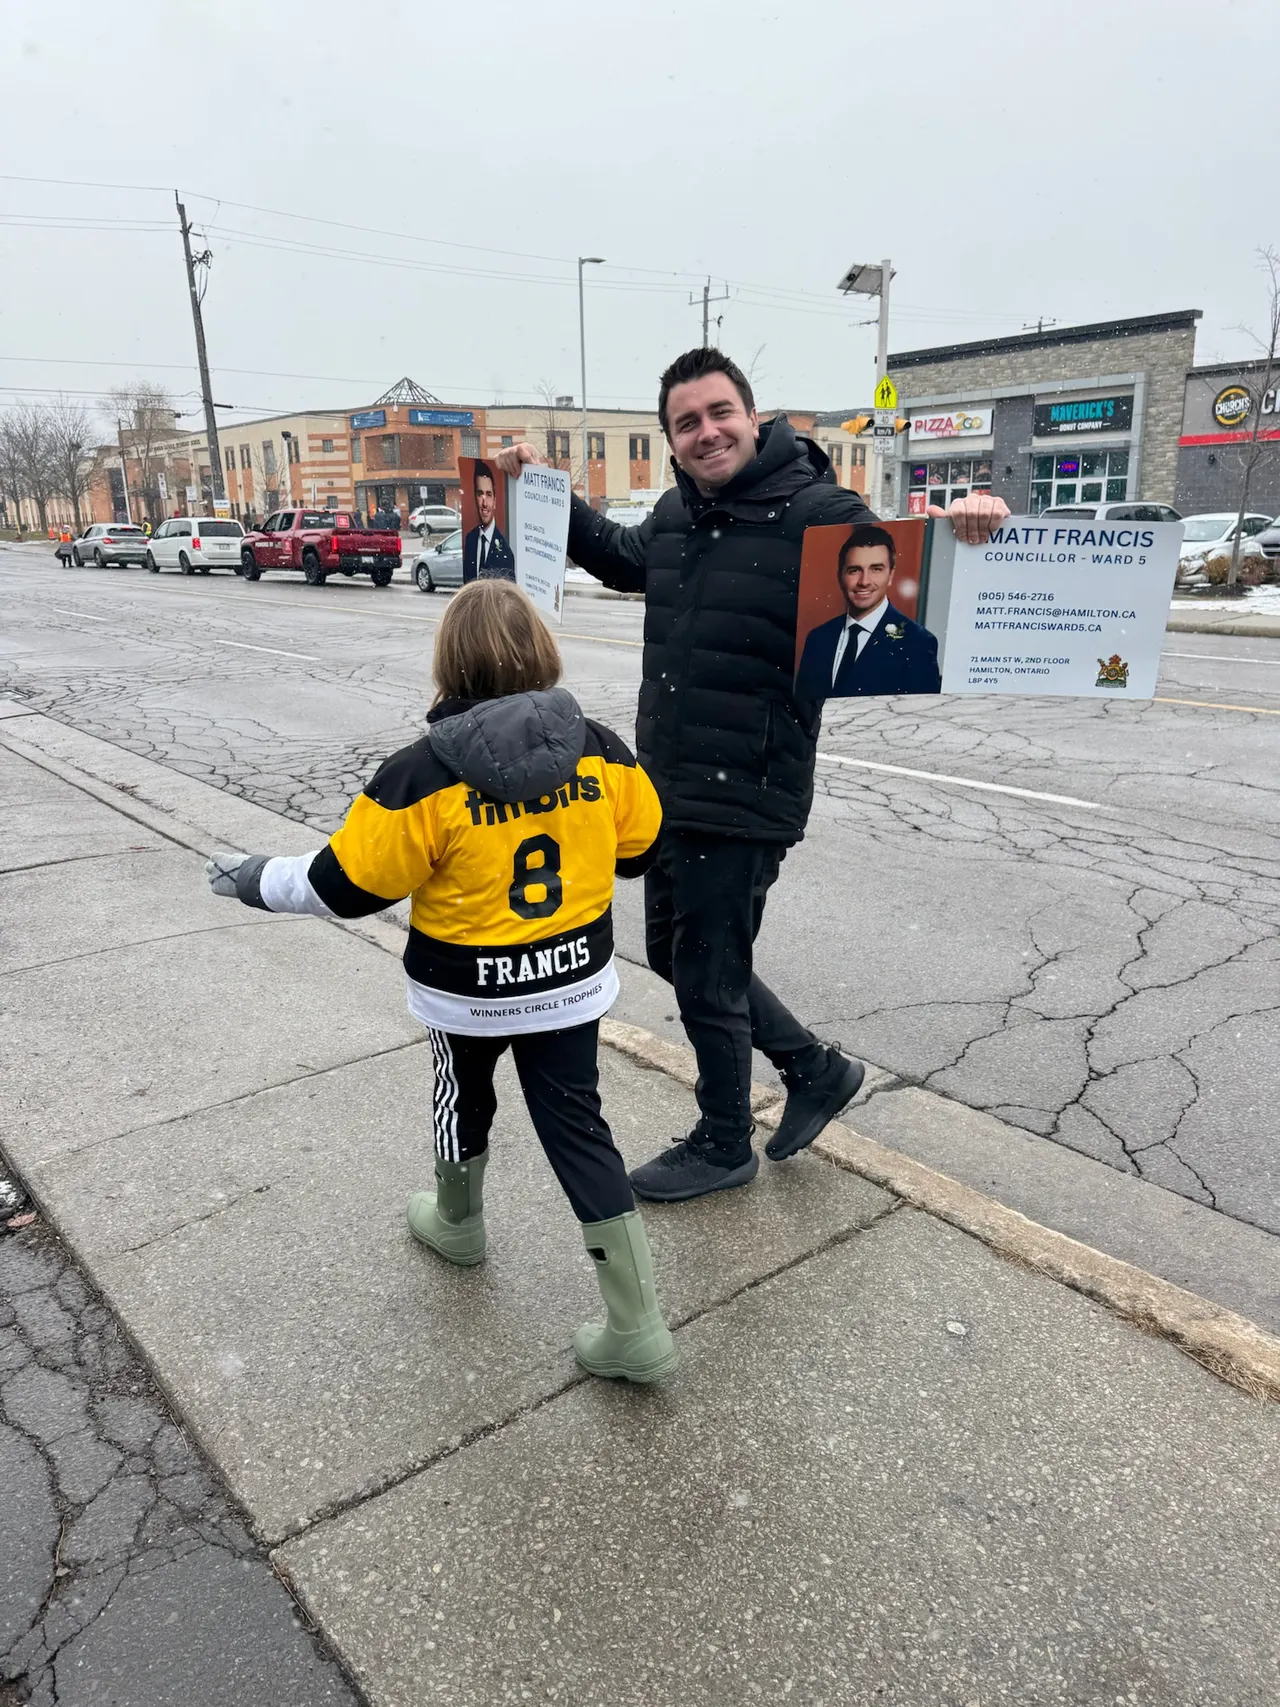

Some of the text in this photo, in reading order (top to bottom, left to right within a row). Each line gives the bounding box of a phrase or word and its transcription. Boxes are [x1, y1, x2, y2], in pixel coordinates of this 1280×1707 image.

[1051, 400, 1115, 422] MAVERICK'S
[877, 428, 892, 436] km/h
[1059, 420, 1103, 432] DONUT COMPANY
[524, 471, 566, 493] MATT FRANCIS
[986, 528, 1154, 547] MATT FRANCIS
[985, 552, 1076, 563] COUNCILLOR
[1092, 554, 1133, 565] WARD
[1139, 555, 1146, 565] 5
[978, 592, 1054, 602] (905) 546-2716
[976, 607, 1136, 619] MATT.FRANCIS@HAMILTON.CA
[975, 621, 1102, 632] MATTFRANCISWARD5.CA
[1013, 657, 1023, 665] W,
[1043, 657, 1070, 665] FLOOR
[969, 667, 1013, 675] HAMILTON,
[508, 833, 563, 920] 8
[476, 936, 590, 986] FRANCIS
[470, 982, 603, 1018] WINNERS CIRCLE TROPHIES
